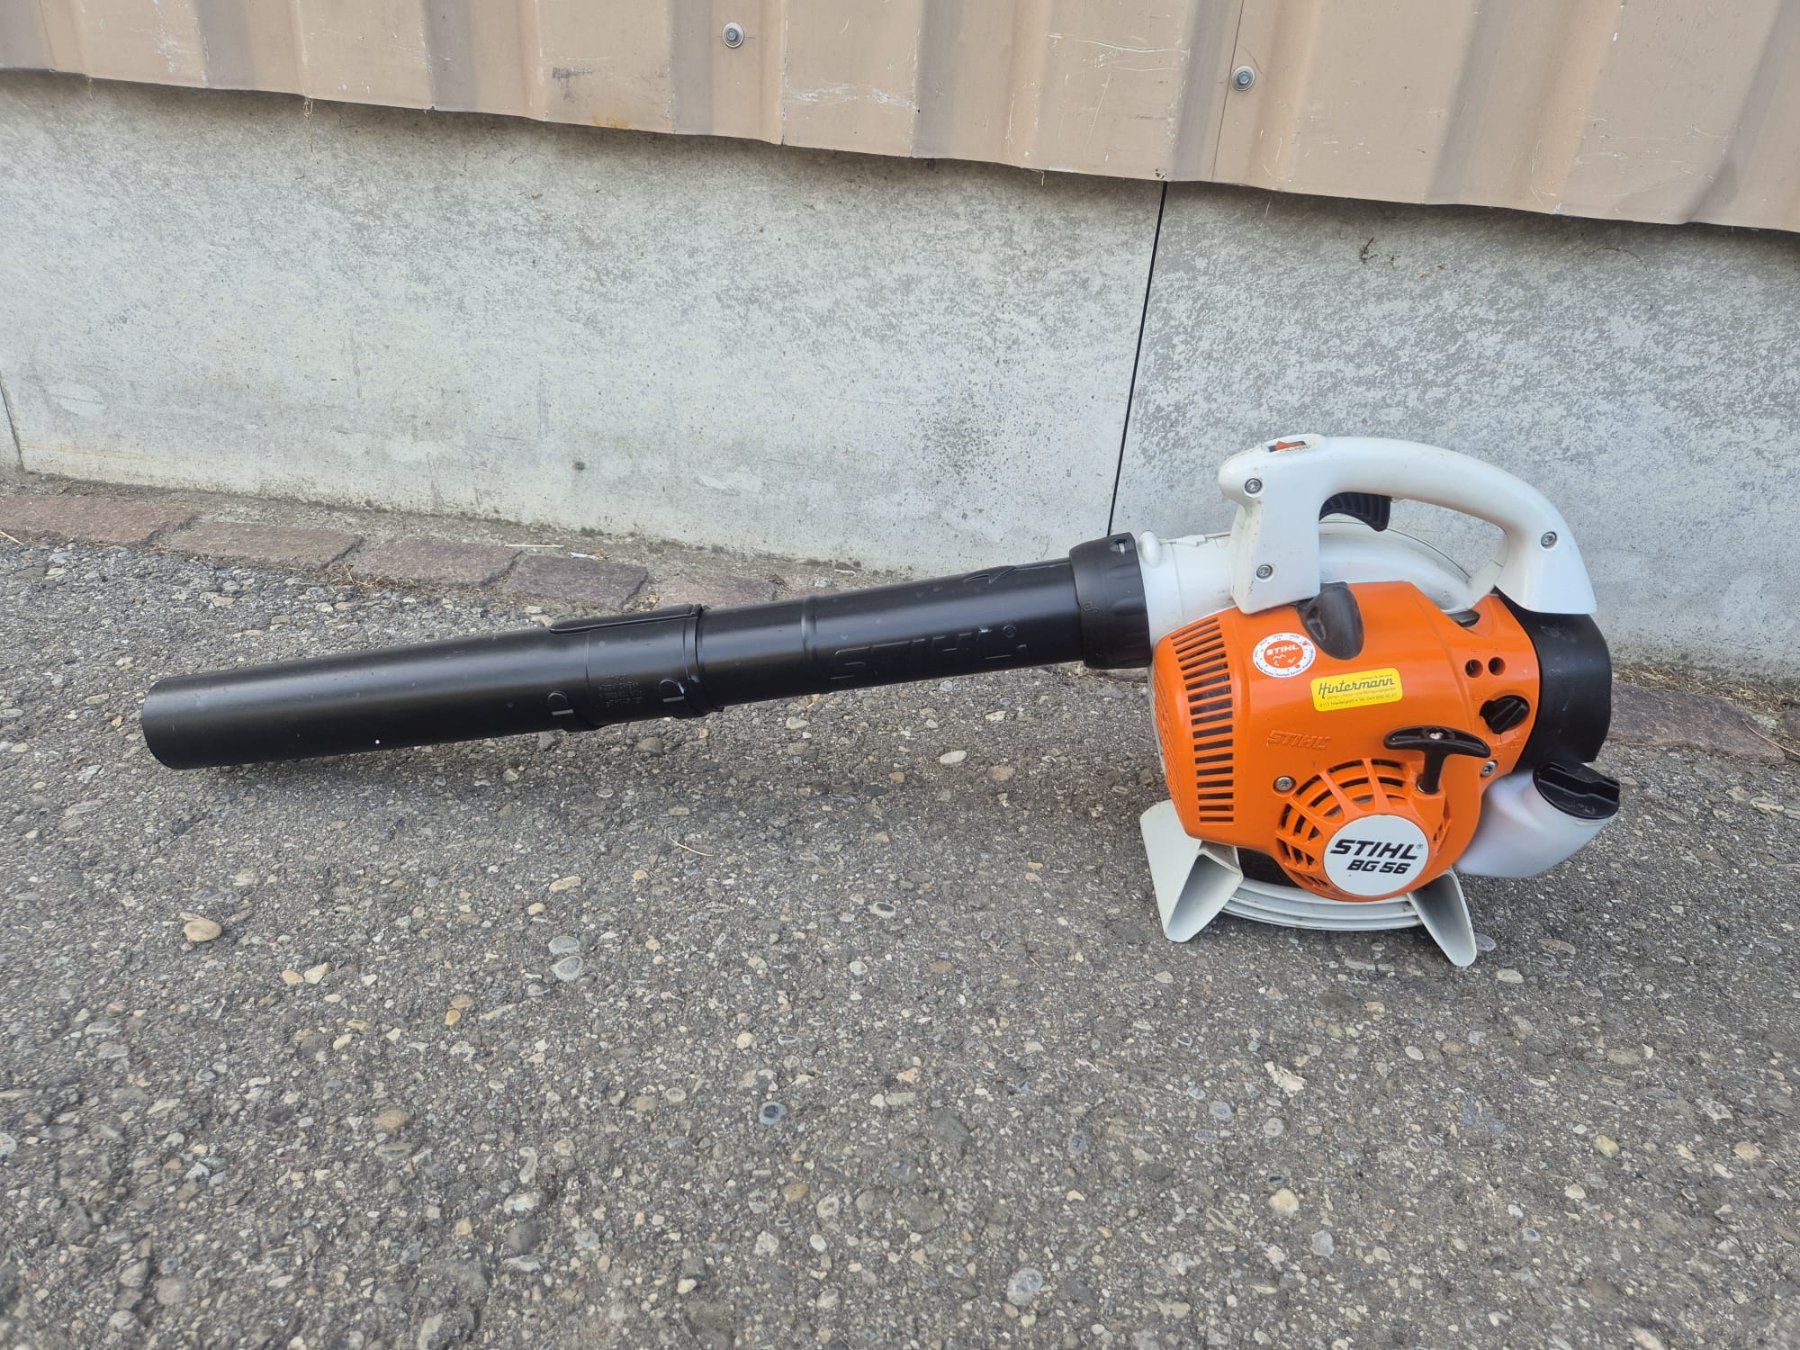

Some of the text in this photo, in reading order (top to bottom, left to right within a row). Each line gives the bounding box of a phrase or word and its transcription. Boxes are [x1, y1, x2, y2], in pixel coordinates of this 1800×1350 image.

[1266, 644, 1300, 656] STIHL
[1318, 677, 1395, 699] Hintermann
[1266, 729, 1332, 750] STIHL
[1330, 838, 1418, 860] STIHL
[1347, 859, 1411, 875] BG 56
